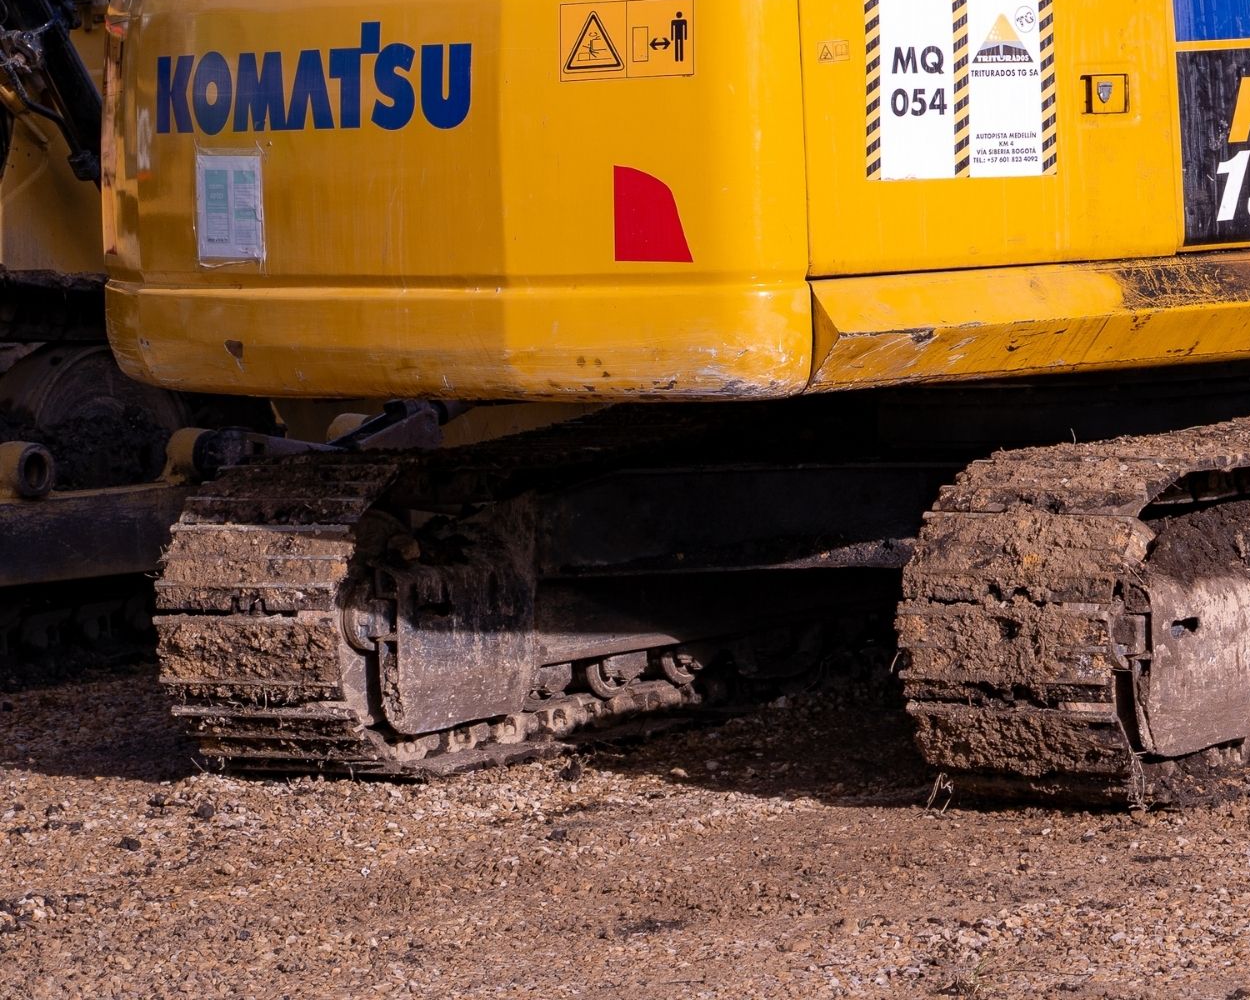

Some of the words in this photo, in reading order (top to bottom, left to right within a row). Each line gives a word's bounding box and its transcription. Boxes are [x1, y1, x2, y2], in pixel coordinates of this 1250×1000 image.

[891, 46, 944, 75] MQ
[976, 54, 1030, 62] TRITURADOS
[156, 21, 472, 135] KOMATSU
[971, 69, 1016, 78] TRITURADOS
[1017, 69, 1027, 77] TG
[1029, 69, 1039, 77] SA
[891, 88, 948, 117] 054
[1009, 131, 1037, 139] MEDELLÍN
